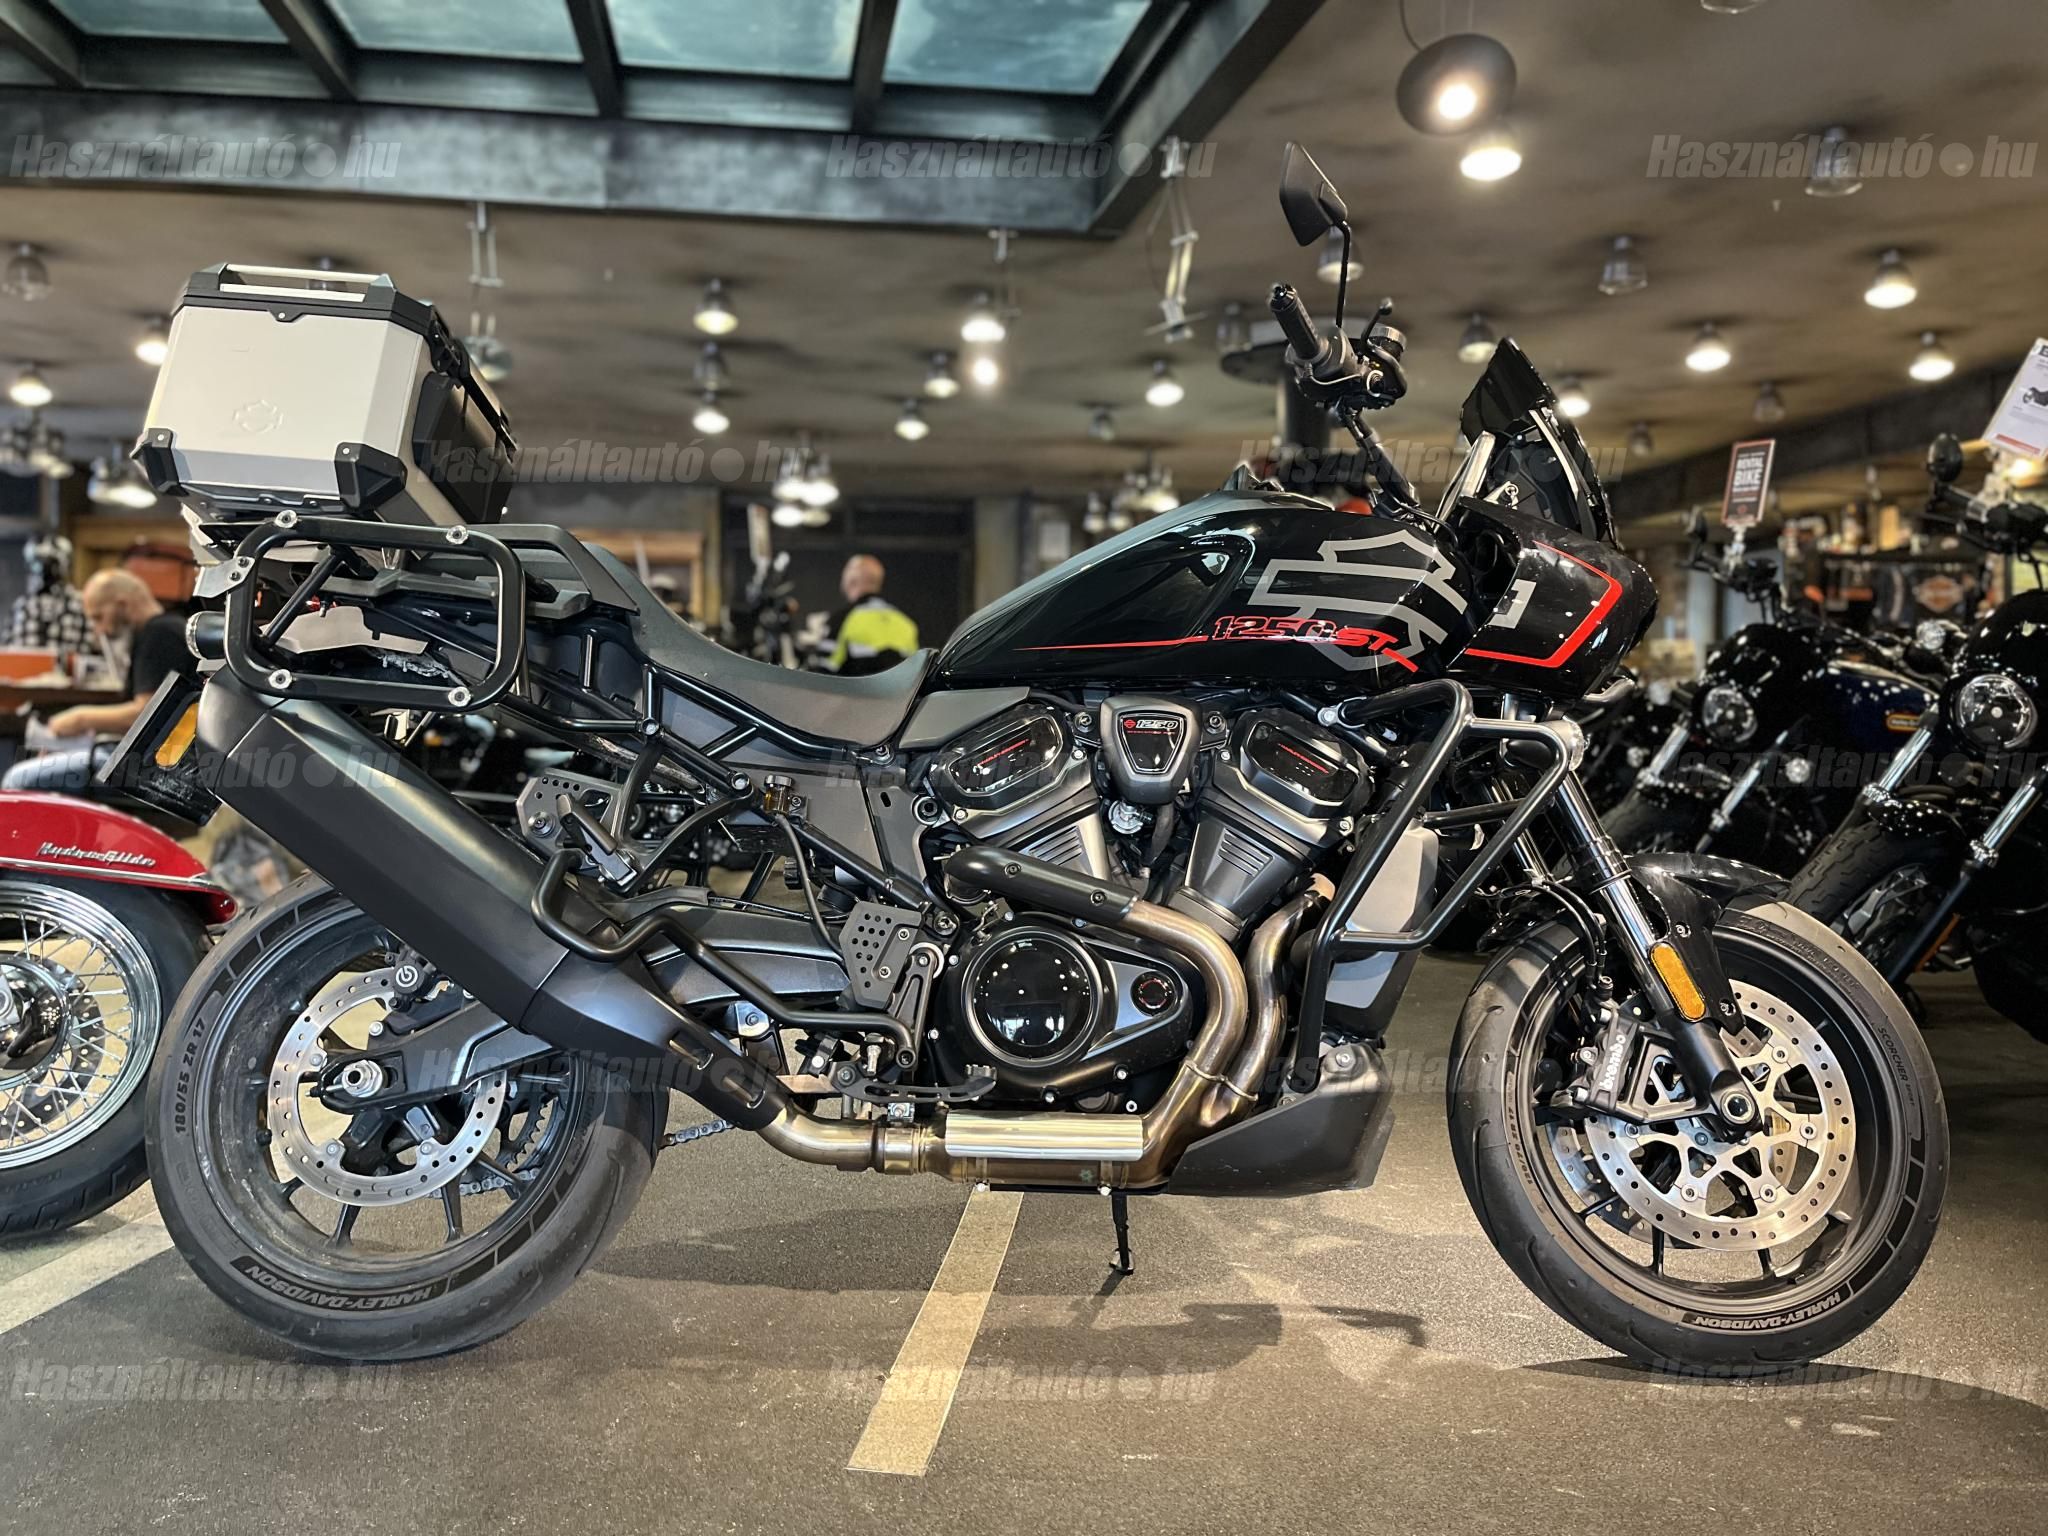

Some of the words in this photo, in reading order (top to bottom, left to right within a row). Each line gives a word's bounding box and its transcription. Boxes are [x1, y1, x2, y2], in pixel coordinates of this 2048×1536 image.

[1733, 468, 1762, 486] BIKE
[192, 1020, 205, 1039] 17
[182, 1041, 198, 1066] ZR
[1599, 1034, 1626, 1090] brembo
[1877, 1026, 1909, 1081] SCORCHER
[175, 1071, 190, 1134] 180/55
[244, 1266, 433, 1311] HARLEY-DAVIDSON
[1693, 1291, 1841, 1330] HARLEY-DAVIDSON
